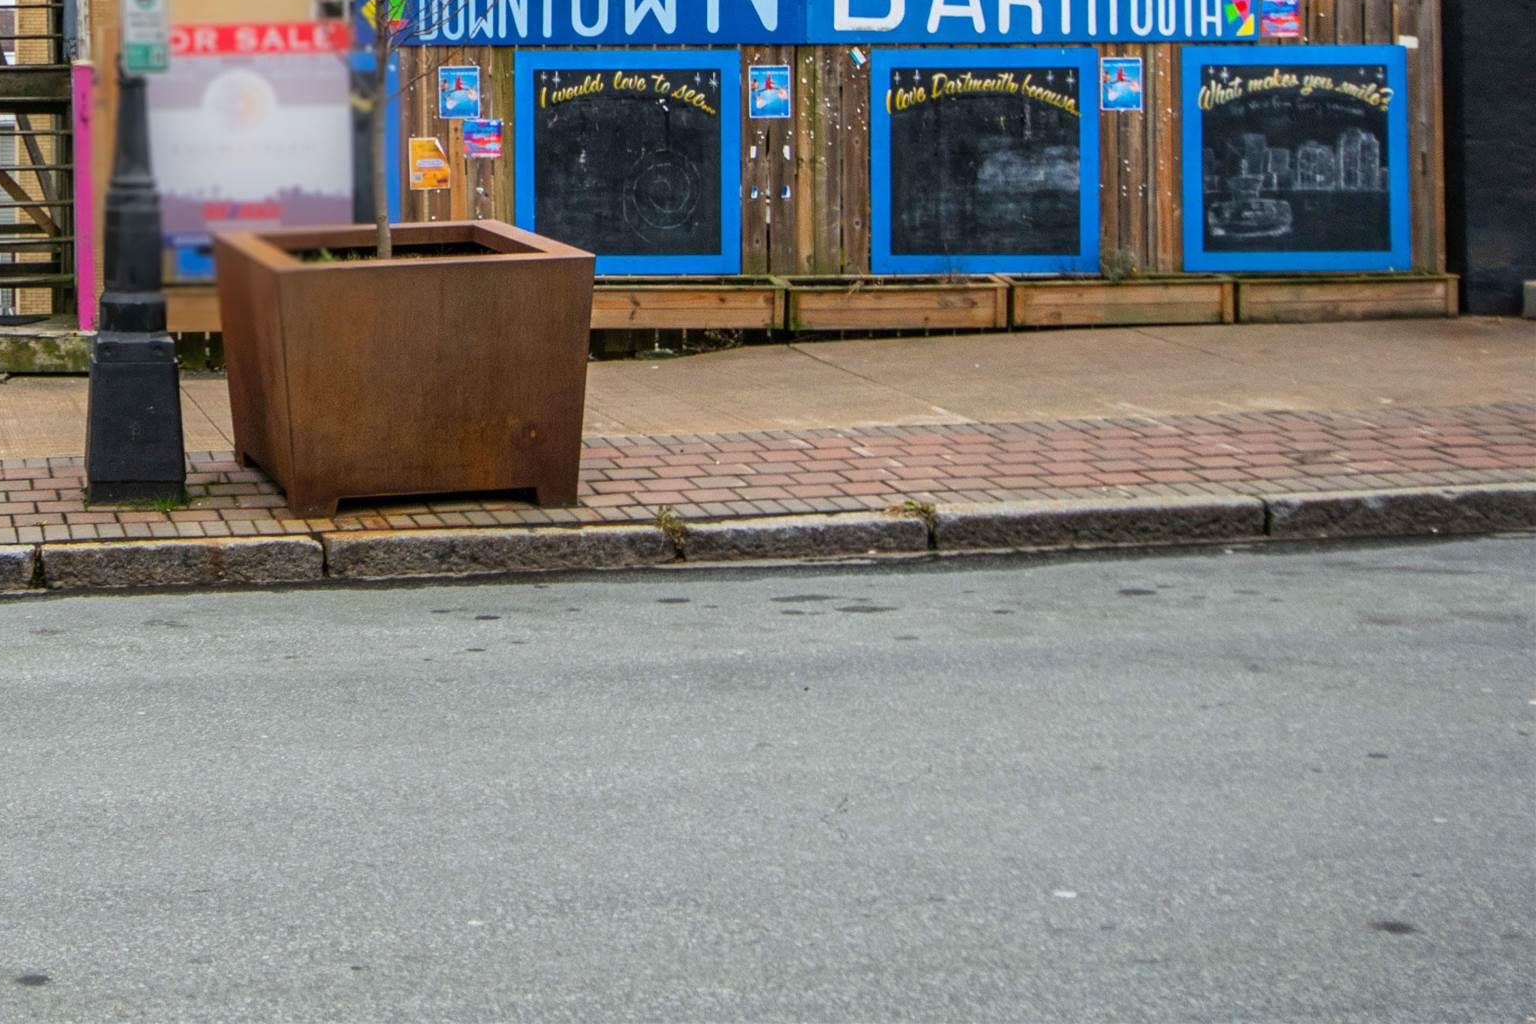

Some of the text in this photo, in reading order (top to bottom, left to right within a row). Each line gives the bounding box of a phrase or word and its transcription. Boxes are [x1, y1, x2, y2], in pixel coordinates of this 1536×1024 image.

[539, 86, 547, 108] I
[551, 73, 604, 104] would
[613, 70, 647, 90] love
[651, 73, 671, 95] to
[885, 89, 892, 114] I
[895, 86, 927, 111] love
[931, 72, 1018, 98] Dartmouth
[1197, 76, 1243, 110] What
[1247, 68, 1299, 92] makes
[1300, 74, 1333, 95] you
[1335, 81, 1394, 111] smile?
